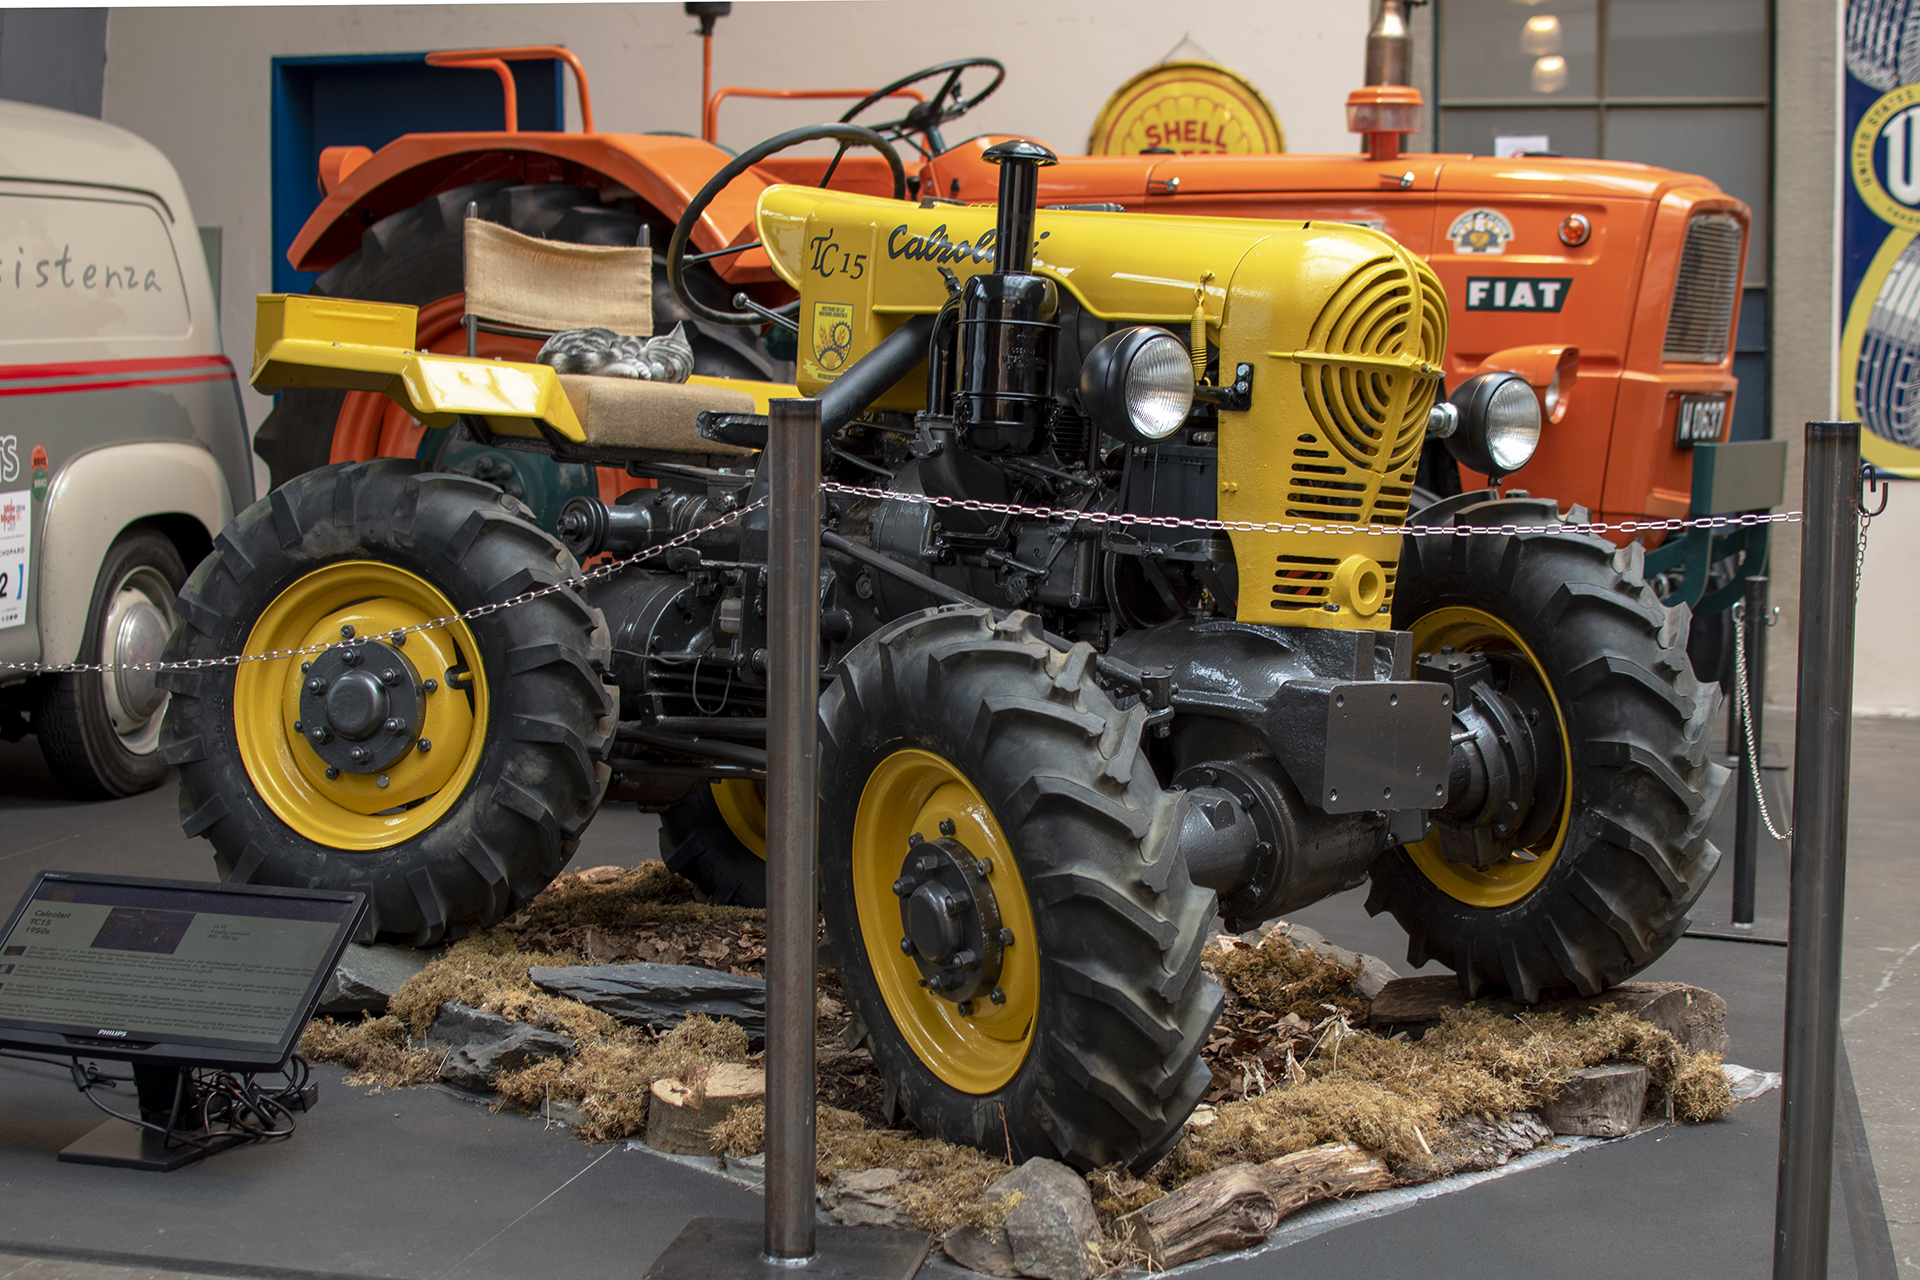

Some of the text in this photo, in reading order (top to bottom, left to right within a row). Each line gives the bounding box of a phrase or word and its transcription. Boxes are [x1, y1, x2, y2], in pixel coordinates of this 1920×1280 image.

[1868, 89, 1915, 127] STATES
[1145, 120, 1227, 148] SHELL
[810, 228, 867, 279] TC 15
[0, 243, 162, 292] istenza
[1468, 281, 1561, 308] FIAT
[29, 918, 52, 926] TC15
[34, 910, 72, 920] Calzolari
[24, 926, 51, 935] 1950s
[97, 1029, 128, 1038] PHILIPS
